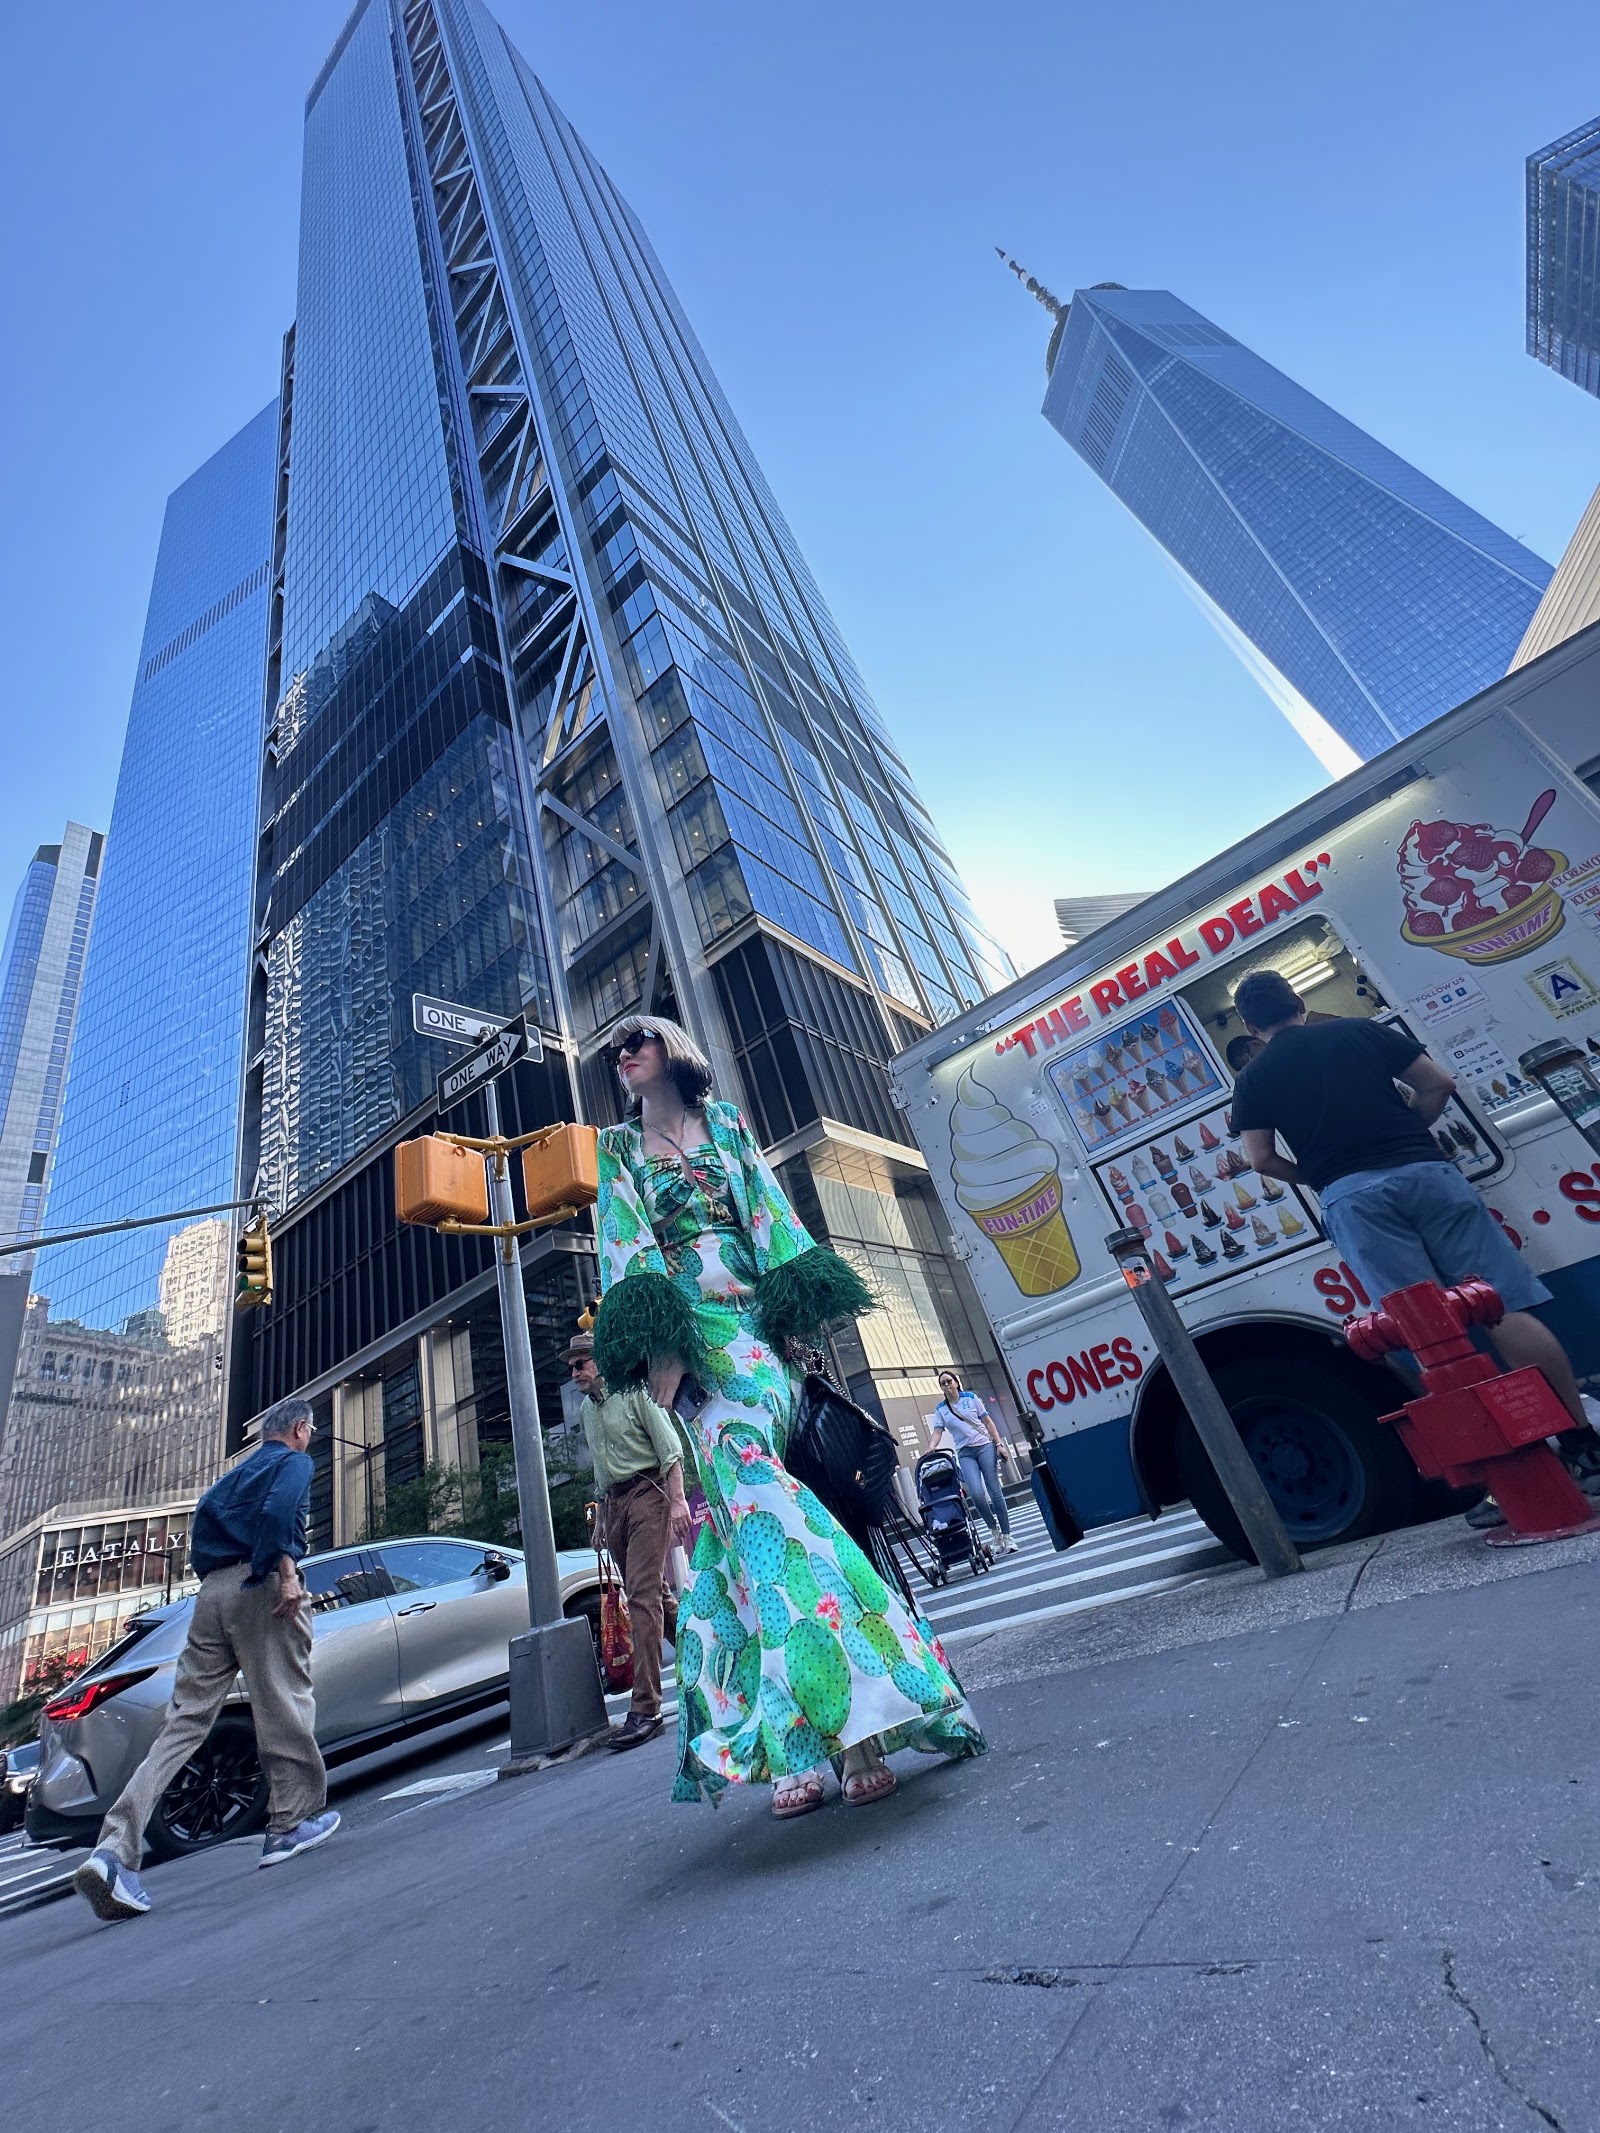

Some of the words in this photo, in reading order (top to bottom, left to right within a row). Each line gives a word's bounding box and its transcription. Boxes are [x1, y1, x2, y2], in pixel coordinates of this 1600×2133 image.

[1548, 875, 1564, 888] ICE
[1562, 860, 1594, 881] CREAM
[1571, 893, 1587, 906] ICE
[1459, 902, 1554, 956] FUN-TIME
[1089, 937, 1200, 1018] REAL
[1415, 982, 1451, 1003] FOLLOW
[1452, 976, 1465, 987] US
[1551, 974, 1581, 1000] A
[427, 1009, 467, 1032] ONE
[1463, 1040, 1489, 1055] Square
[450, 1063, 476, 1092] ONE
[485, 1035, 512, 1067] WAY
[981, 1186, 1059, 1235] FUN-TIME
[1026, 1336, 1143, 1411] CONES
[60, 1532, 185, 1567] EATALY
